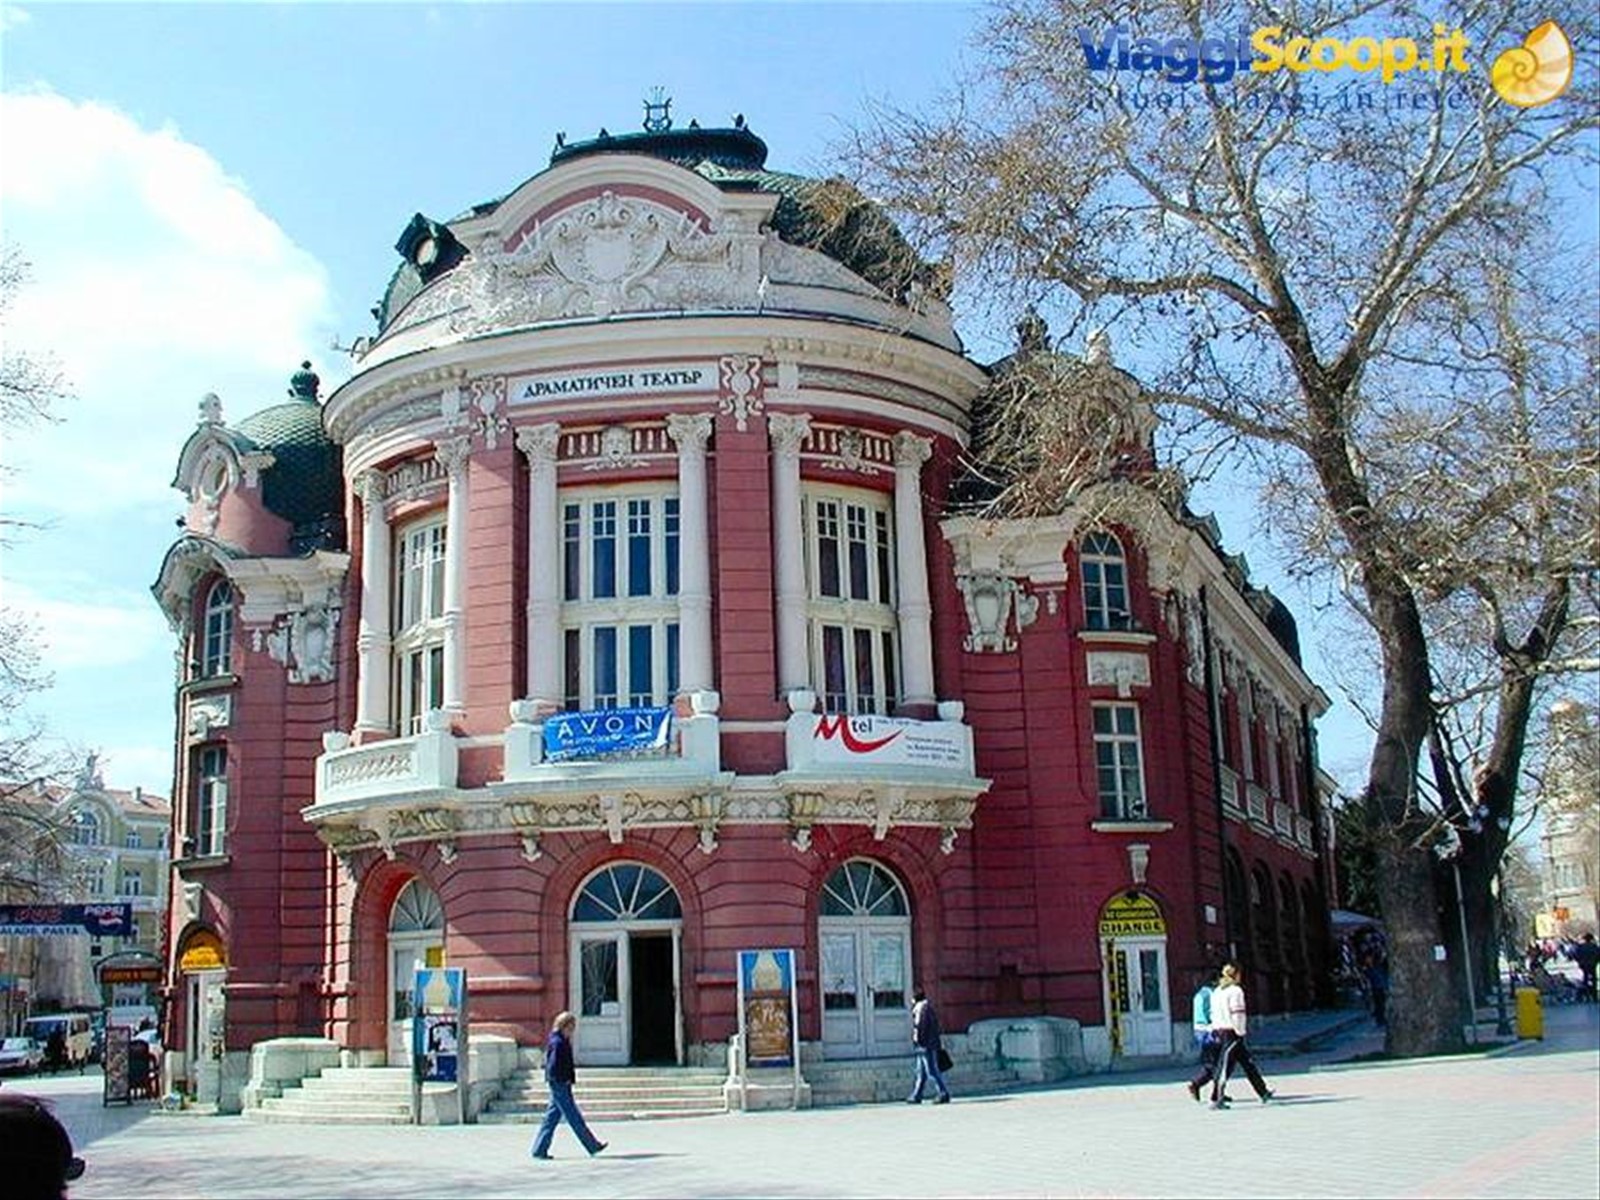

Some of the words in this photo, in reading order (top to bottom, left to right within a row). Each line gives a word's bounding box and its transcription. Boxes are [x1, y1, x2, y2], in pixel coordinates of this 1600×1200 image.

[641, 370, 703, 387] ТЕАТЪР
[557, 715, 654, 740] AVON
[84, 905, 125, 917] PEPSI
[42, 926, 79, 937] PASTA
[1101, 921, 1161, 934] CHANGE
